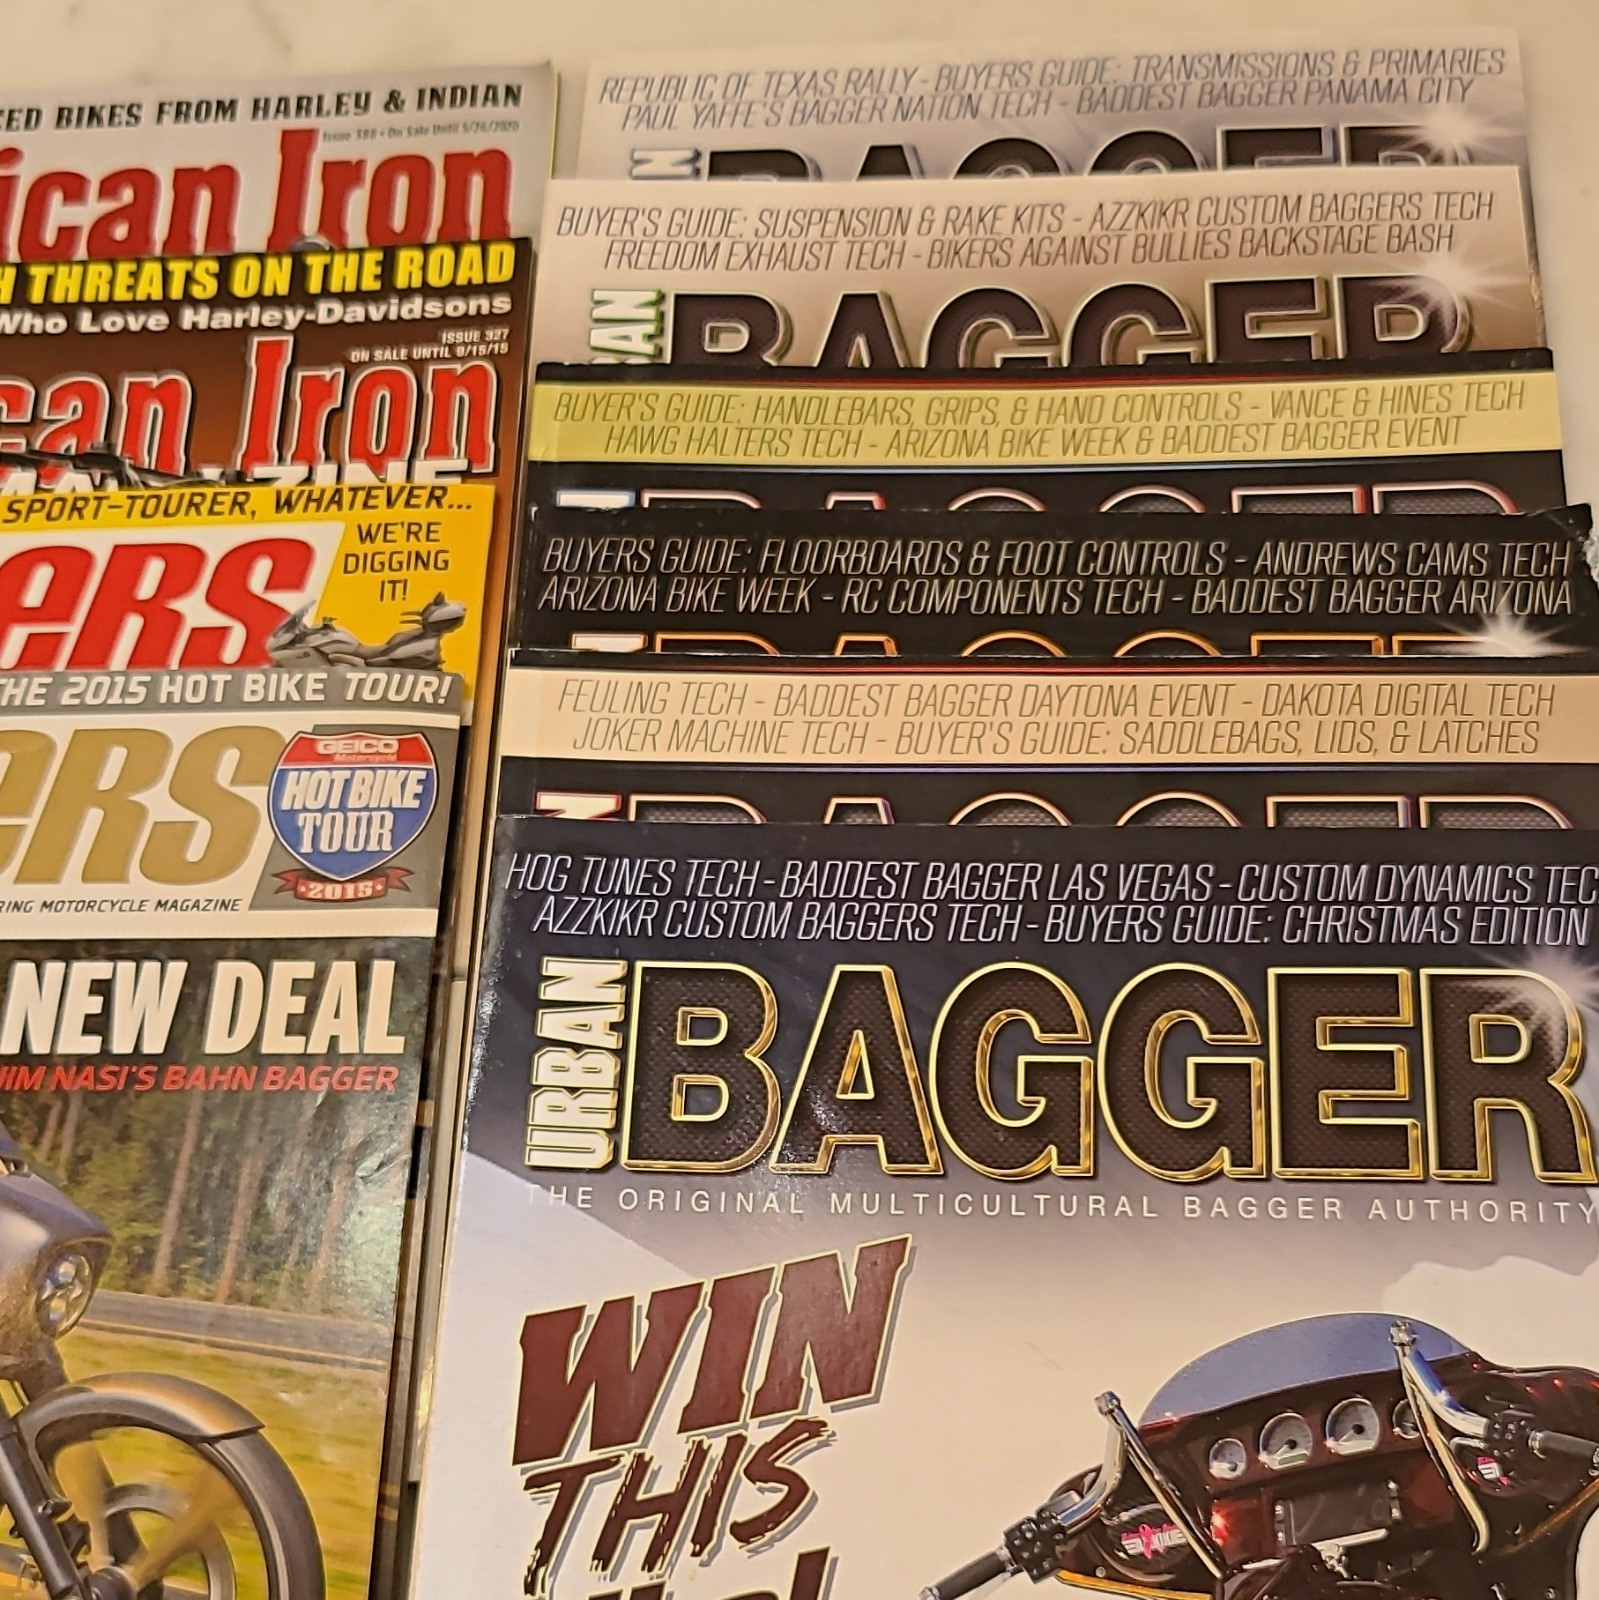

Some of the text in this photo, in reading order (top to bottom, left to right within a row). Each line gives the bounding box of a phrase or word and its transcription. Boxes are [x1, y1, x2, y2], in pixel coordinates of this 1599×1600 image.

[601, 48, 1505, 103] REPUBLIC TEXAS RALLY BUYERS GUIDE: TRANSMISSIONS PRIMARIES
[56, 84, 522, 130] BIKES FROM HARLEY INDIAN
[622, 77, 1474, 129] PAUL YAFFE'S BAGGER NATION BADDEST BAGGER PANAMA CITY
[267, 128, 511, 252] Iron
[557, 191, 1493, 239] BUYER'S GUIDE: SUSPENSION RAKE KITS AZZKIKR CUSTOM BAGGERS TECH
[603, 223, 1453, 272] FREEDOM EXHAUST BIKERS AGAINST BULLIES BACKSTAGE BASH
[29, 259, 220, 304] THREATS
[230, 255, 292, 298] ON
[305, 252, 383, 293] THE
[395, 244, 515, 290] ROAD
[0, 294, 512, 335] Who Love Harley-Davidsons
[351, 350, 370, 363] ON
[374, 348, 408, 361] SALE
[412, 346, 450, 359] UNTIL
[441, 330, 481, 344] ISSUE
[236, 335, 498, 480] Iron
[553, 380, 1526, 427] BUYER'S GUIDE: HANDLEBARS, GRIPS, HAND CONTROLS VANCE HINES TECH
[604, 416, 1466, 458] HAWG HALTERS ARIZONA BIKE WEEK BADDEST BAGGER EVENT
[2, 491, 256, 523] SPORT-TOURER,
[357, 521, 442, 545] WE'RE
[343, 550, 450, 575] DIGGING
[542, 537, 1573, 578] BUYERS GUIDE: FLOORBOARDS FOOT CONTROLS ANDREWS CAMS TECH
[379, 579, 408, 602] IT!
[537, 576, 1574, 616] ARIZONA BIKE WEEK COMPONENTS TECH BADDEST BAGGER ARIZONA
[63, 673, 453, 704] 2015 HOT BIKE TOUR!
[558, 678, 1555, 718] FEULING TECH BADDEST BAGGER DAYTONA EVENT DAKOTA DIGITAL TECH
[316, 739, 399, 754] GEICO
[572, 717, 1539, 756] JOKER MACHINE TECH BUYER'S GUIDE: SADDLEBAGS, LIDS, LATCHES
[281, 770, 426, 810] HOT BIKE
[297, 811, 394, 853] TOUR
[308, 881, 373, 899] 2015
[504, 852, 572, 893] HOG
[580, 856, 677, 896] TUNES
[921, 861, 1043, 901] BAGGER
[1377, 864, 1533, 904] DYNAMICS
[1543, 866, 1599, 904] TEC
[39, 898, 243, 913] MOTORCYCLE MAGAZINE
[532, 896, 658, 936] AZZKIKR
[663, 900, 794, 940] CUSTOM
[800, 902, 937, 943] BAGGERS
[1172, 906, 1272, 944] GUIDE:
[1281, 906, 1462, 945] CHRISTMAS
[1469, 906, 1589, 947] EDITION
[0, 959, 405, 1054] NEW DEAL
[51, 1064, 398, 1092] NASI'S BAHN BAGGER
[523, 955, 1597, 1181] URBAN BAGGER
[525, 1185, 1593, 1223] THE ORIGINAL MULTICULTURAL BAGGER AUTHORITY
[509, 1234, 917, 1472] WIN
[522, 1416, 837, 1597] THIS
